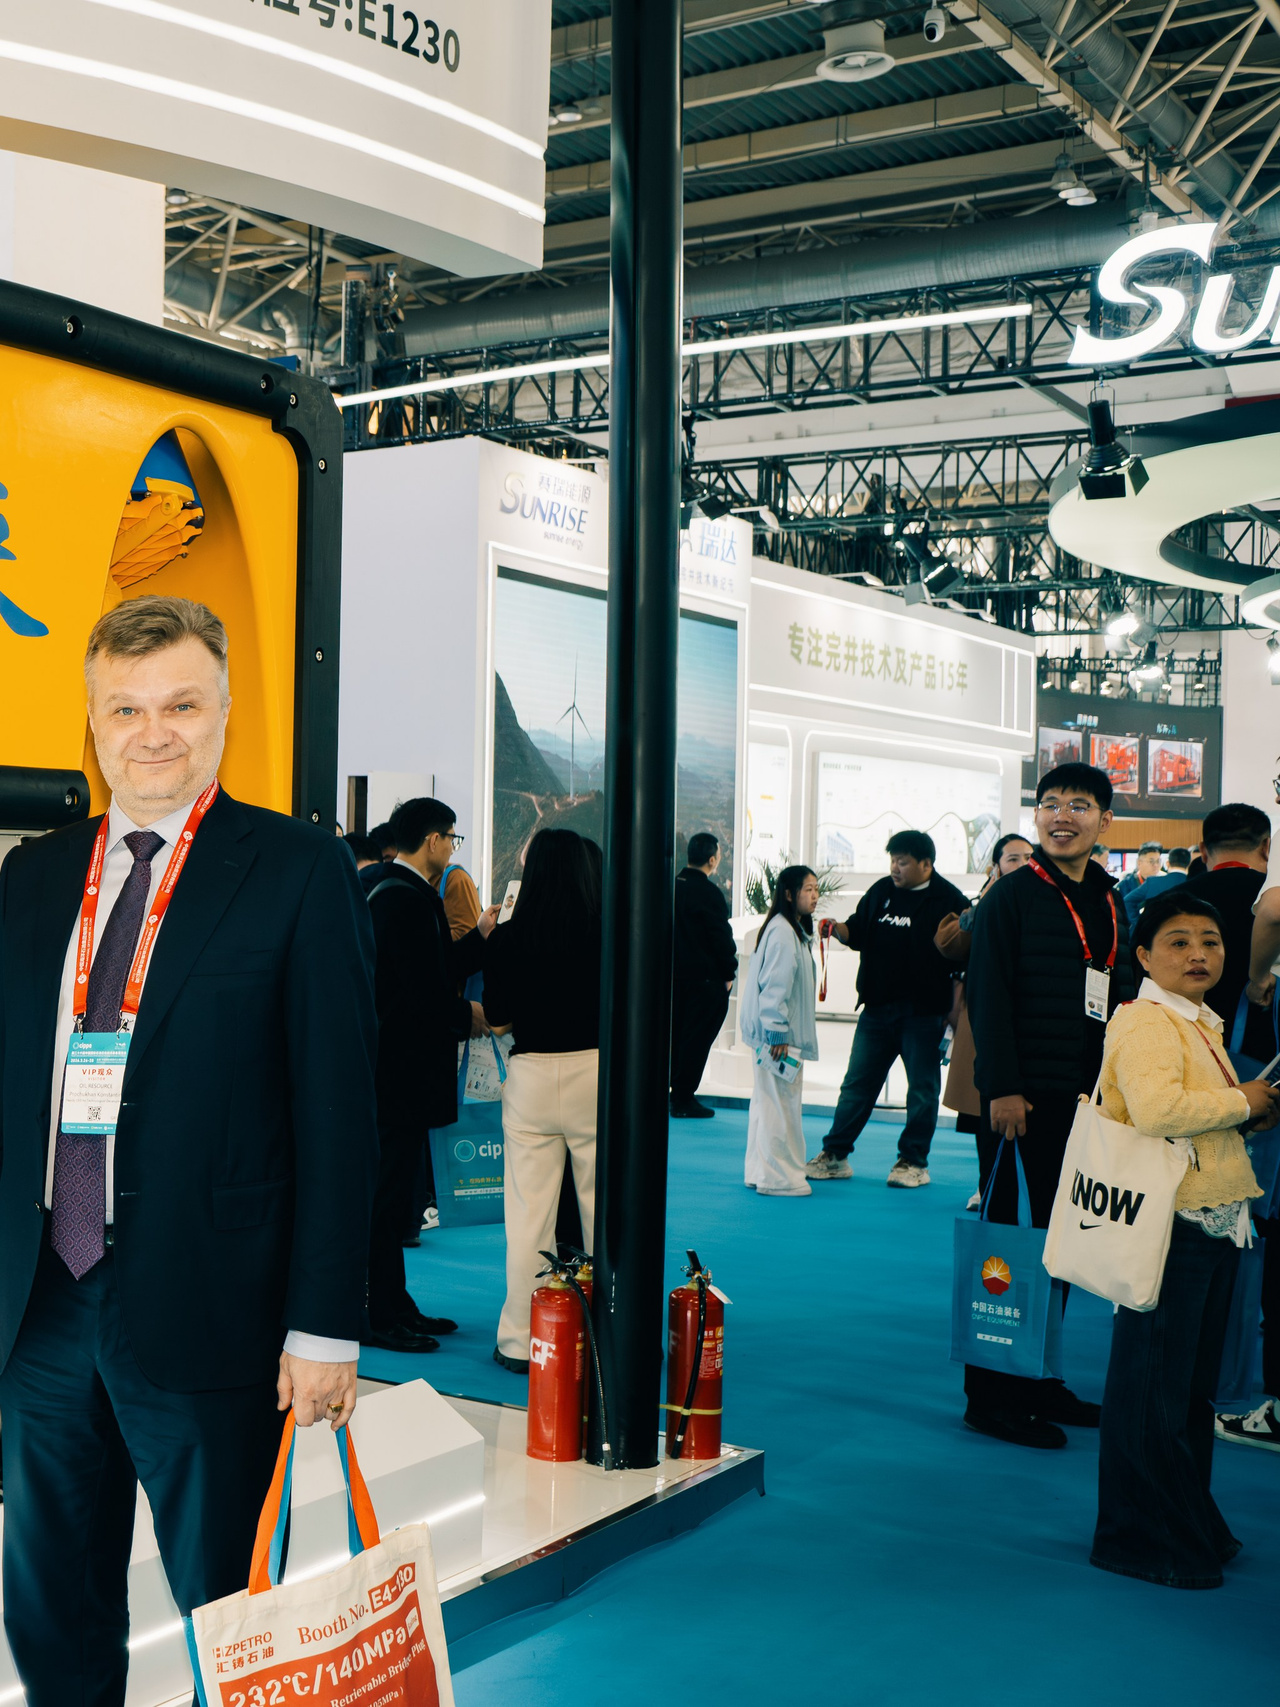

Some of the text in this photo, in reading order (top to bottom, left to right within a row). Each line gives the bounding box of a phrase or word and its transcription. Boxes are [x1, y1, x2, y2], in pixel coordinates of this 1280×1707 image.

[264, 0, 460, 73] 号:E1230
[1067, 222, 1280, 365] Su
[499, 472, 589, 535] SUNRISE
[538, 471, 592, 505] 赛瑞能源
[788, 622, 969, 695] 专注完井技术及产品15年
[82, 1068, 113, 1076] VIP观众
[479, 1140, 504, 1160] cip
[971, 1301, 1021, 1319] 中国石油装备
[297, 1566, 413, 1645] Booth No. E4-130
[216, 1646, 274, 1673] 汇铸石油
[330, 1672, 388, 1707] Retrievable
[387, 1653, 413, 1680] Bridge
